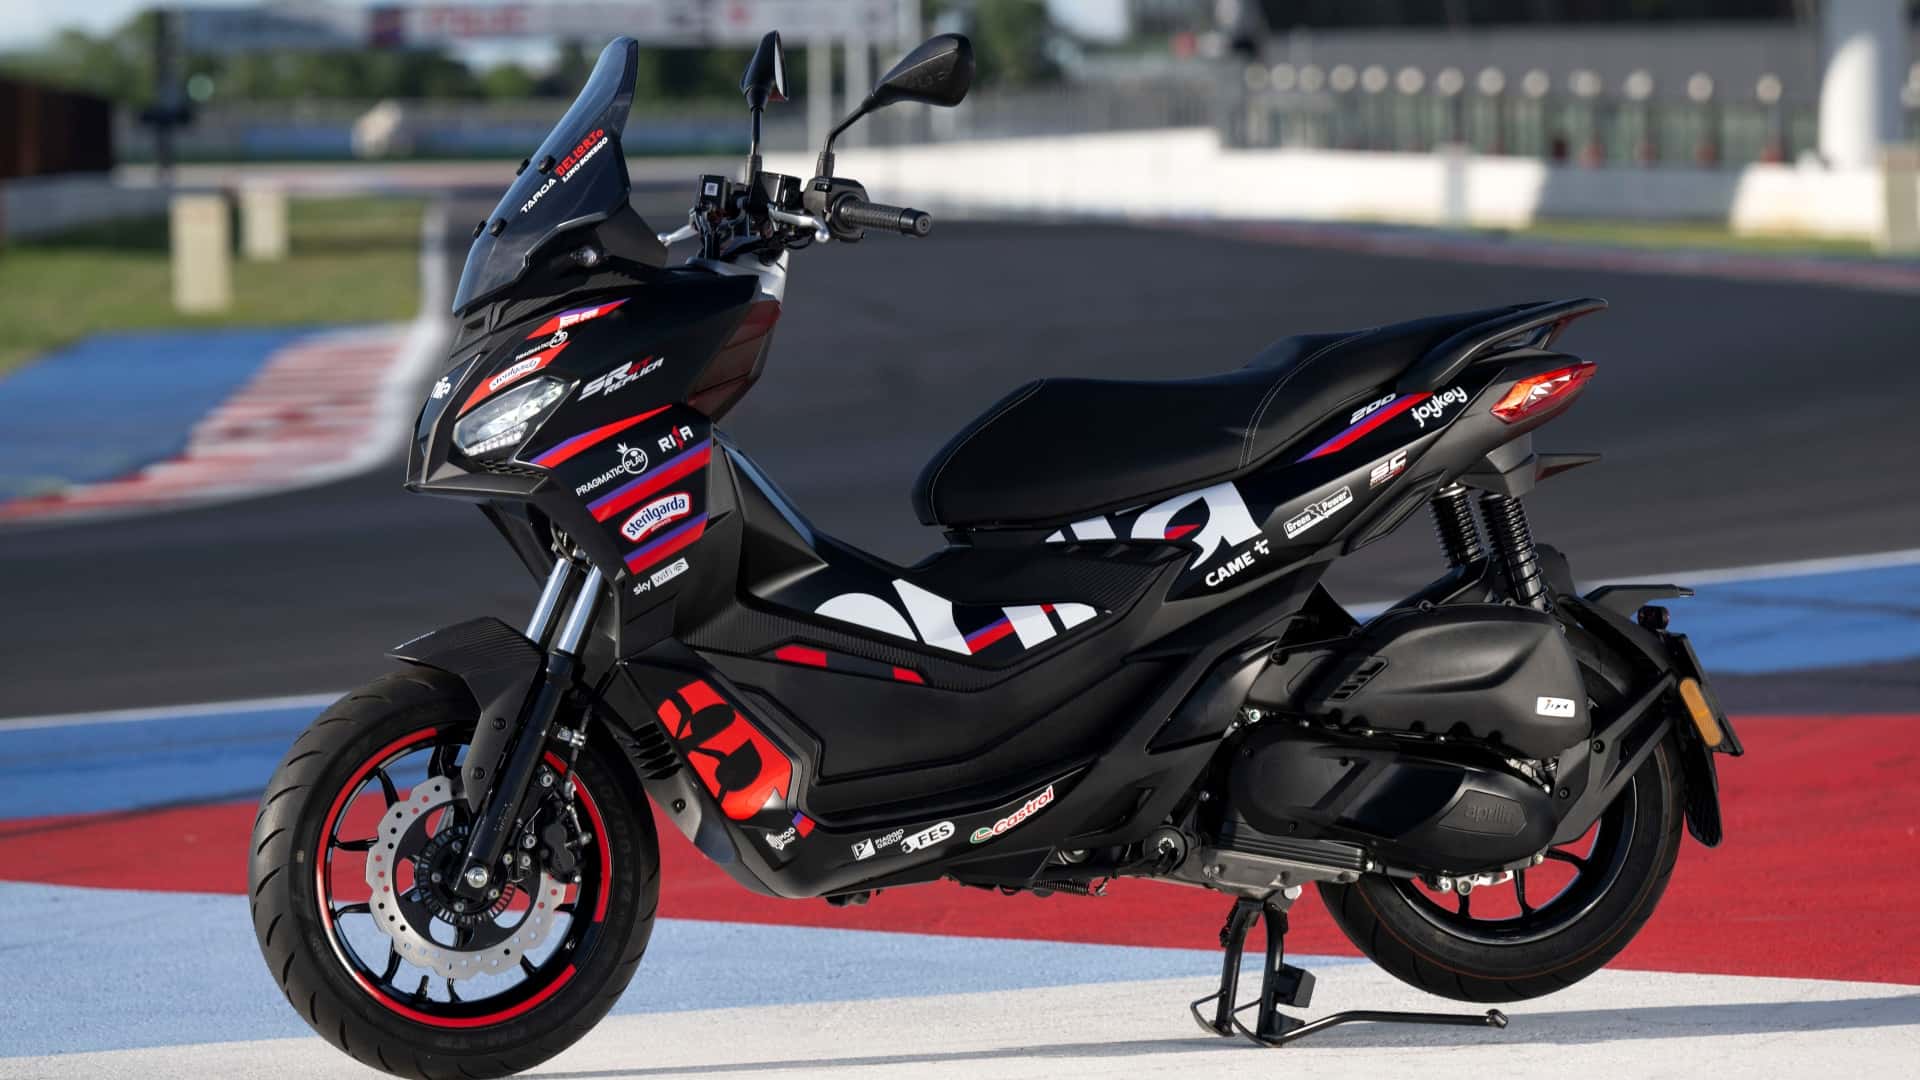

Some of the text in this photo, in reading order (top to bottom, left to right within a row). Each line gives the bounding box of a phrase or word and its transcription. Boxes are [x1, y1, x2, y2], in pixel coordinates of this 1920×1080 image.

[603, 357, 664, 396] REPLICA
[1350, 393, 1396, 425] 200
[576, 452, 645, 497] PRAGMATIC PLAY
[626, 496, 686, 536] sterilgarda
[1285, 491, 1347, 533] Green Power
[633, 579, 651, 595] sky
[1205, 550, 1256, 587] CAME
[992, 784, 1055, 836] Castrol
[875, 828, 904, 844] PIAGGIO
[877, 835, 903, 849] GROUP
[918, 824, 950, 845] FES
